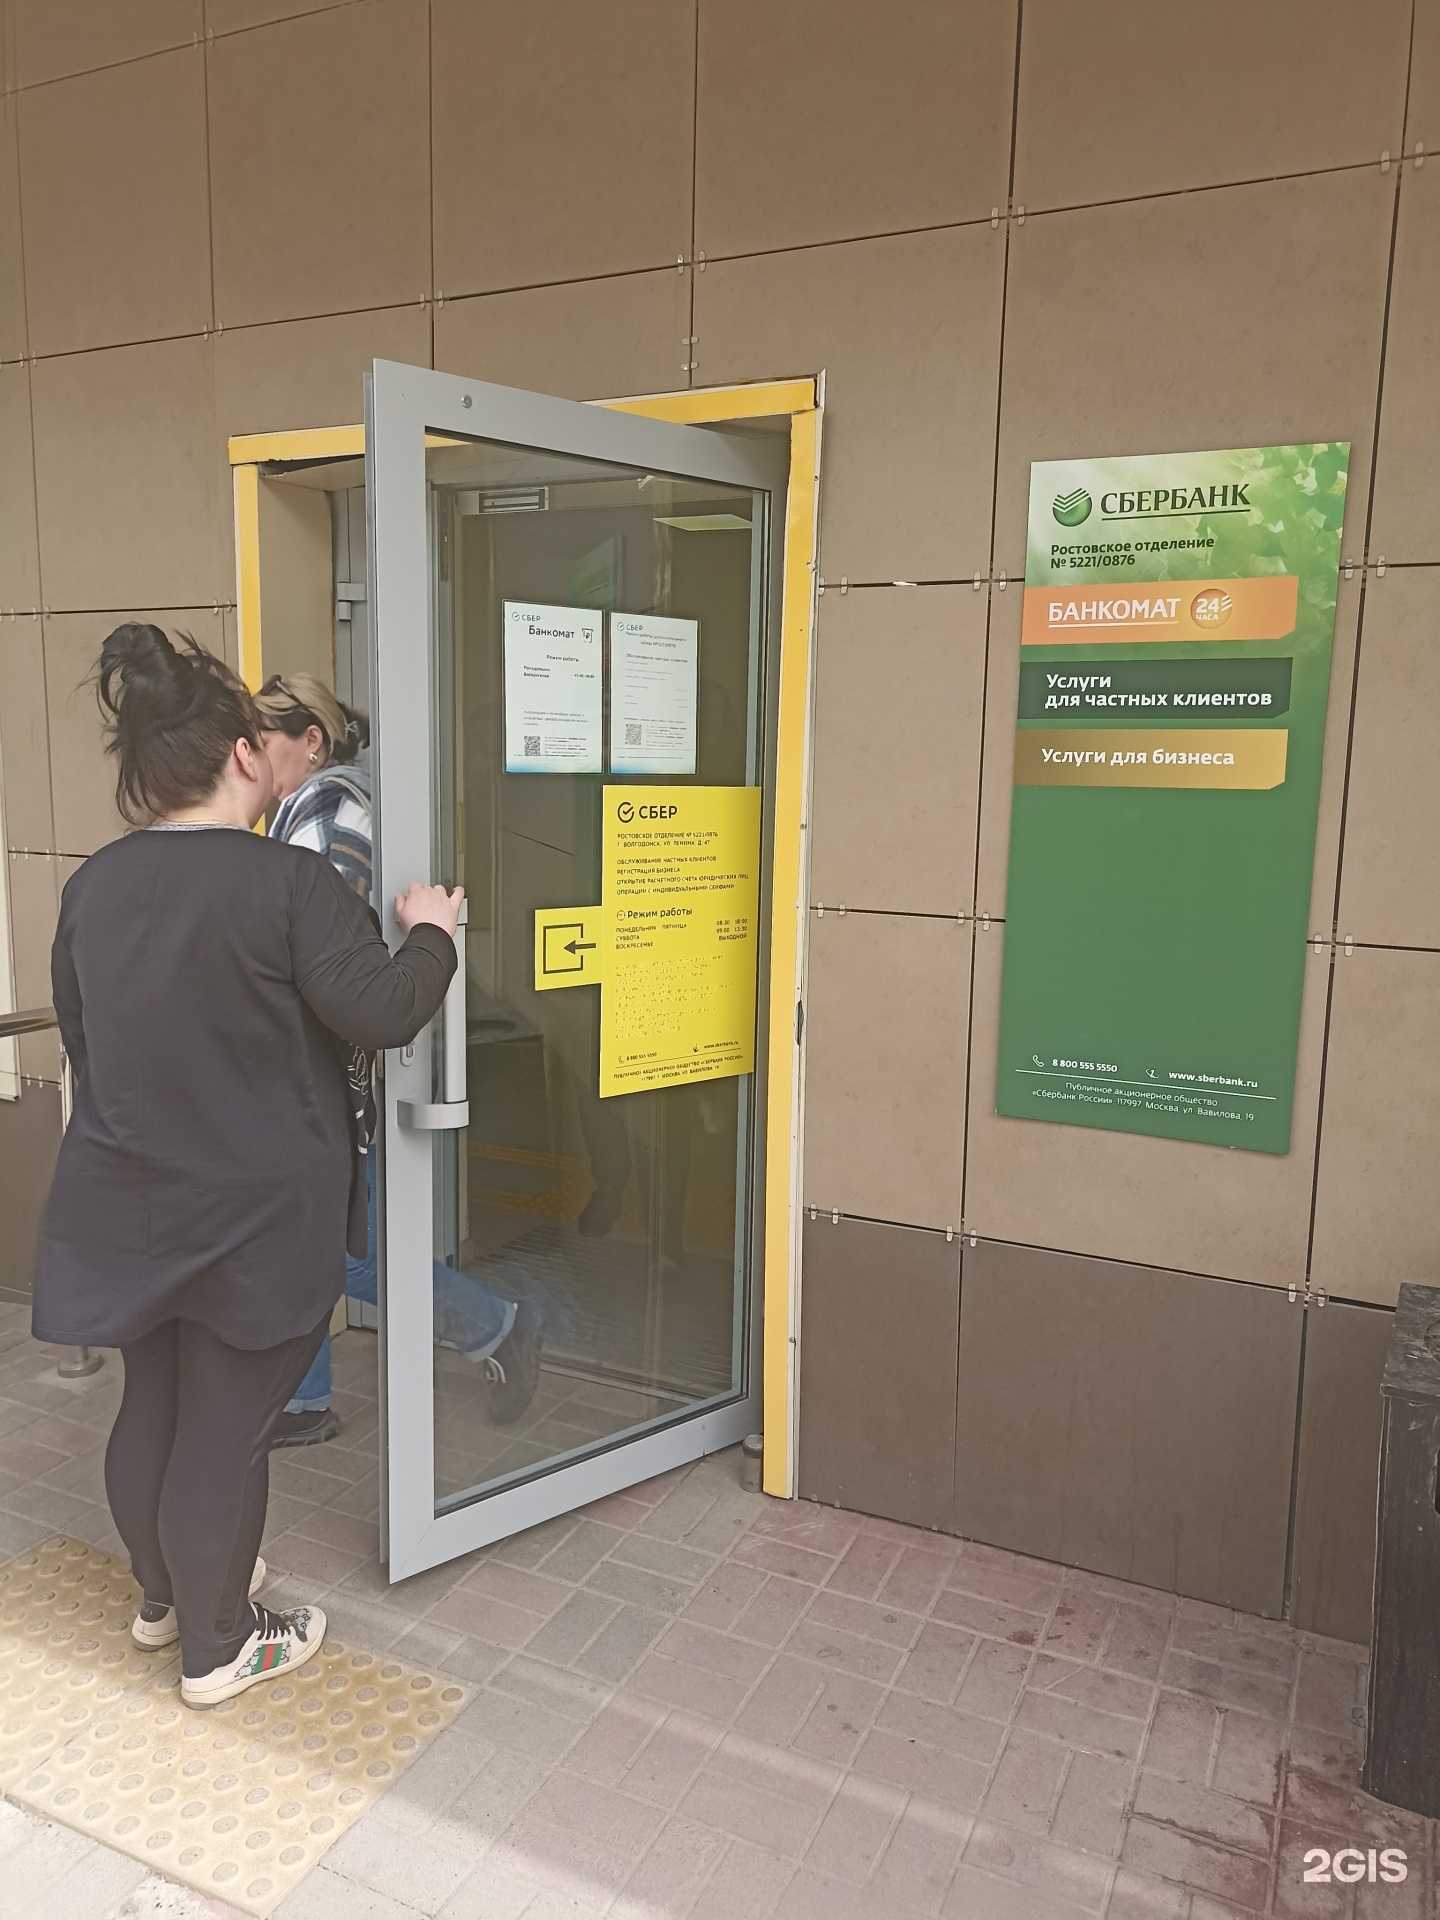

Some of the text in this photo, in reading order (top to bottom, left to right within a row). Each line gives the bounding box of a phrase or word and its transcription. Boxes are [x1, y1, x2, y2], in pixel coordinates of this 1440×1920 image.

[1100, 484, 1251, 515] СБЕРБАНК
[1051, 538, 1215, 556] Ростовское отделение
[1051, 555, 1136, 569] № 5221/0876
[1048, 598, 1219, 622] БАНКОМАТ 24
[529, 625, 575, 639] Банкомат
[1046, 674, 1112, 692] Услуги
[1044, 693, 1272, 709] для частных клиентов
[1041, 748, 1234, 767] Услуги для бизнеса
[639, 805, 678, 819] СБЕР
[628, 907, 692, 919] Режим работы
[1052, 1058, 1118, 1073] 8 800 555 5550
[1169, 1071, 1258, 1088] www.sberbank.ru
[1066, 1082, 1218, 1107] Публичное акционерное общество
[1032, 1089, 1076, 1101] «Сбербанк
[1245, 1113, 1254, 1121] 19
